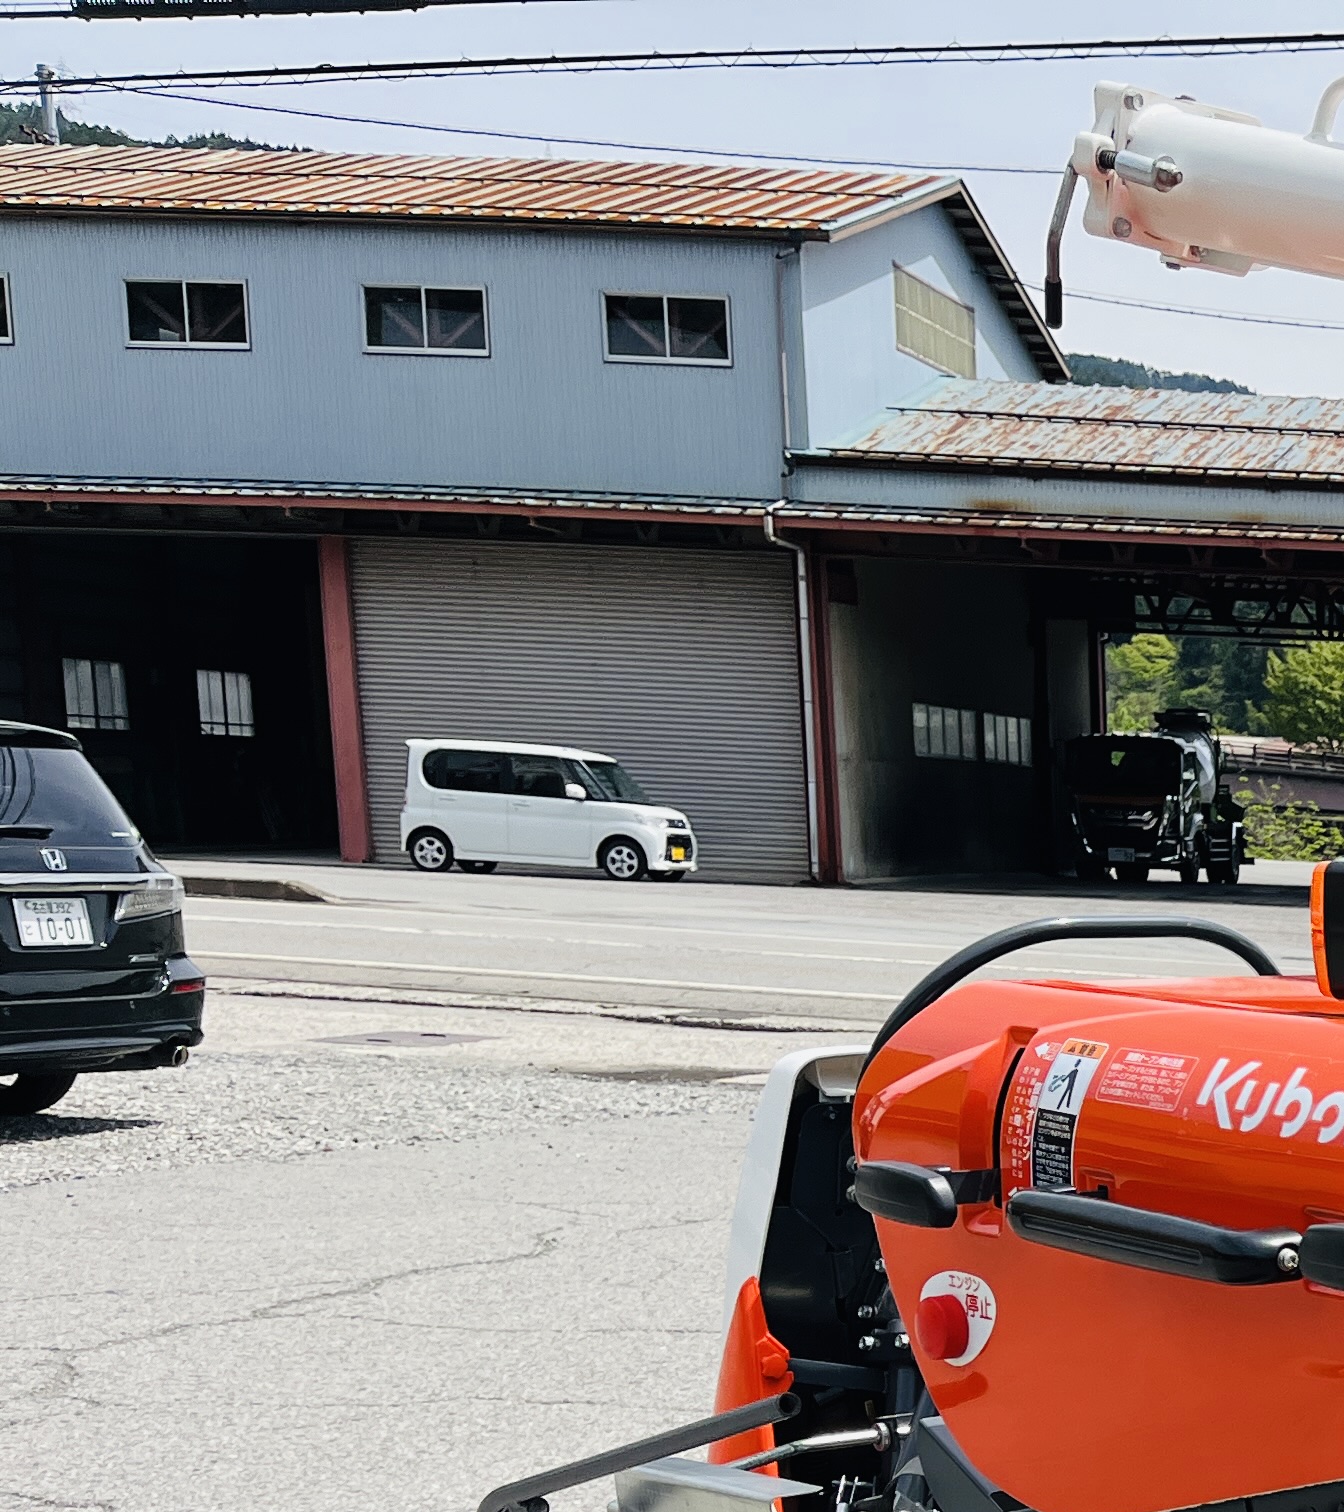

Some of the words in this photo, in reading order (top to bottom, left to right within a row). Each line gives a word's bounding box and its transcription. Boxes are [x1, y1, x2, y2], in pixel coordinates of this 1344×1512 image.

[1022, 1082, 1042, 1160] オープン
[948, 1275, 980, 1292] エンジン
[965, 1293, 992, 1320] 停止
